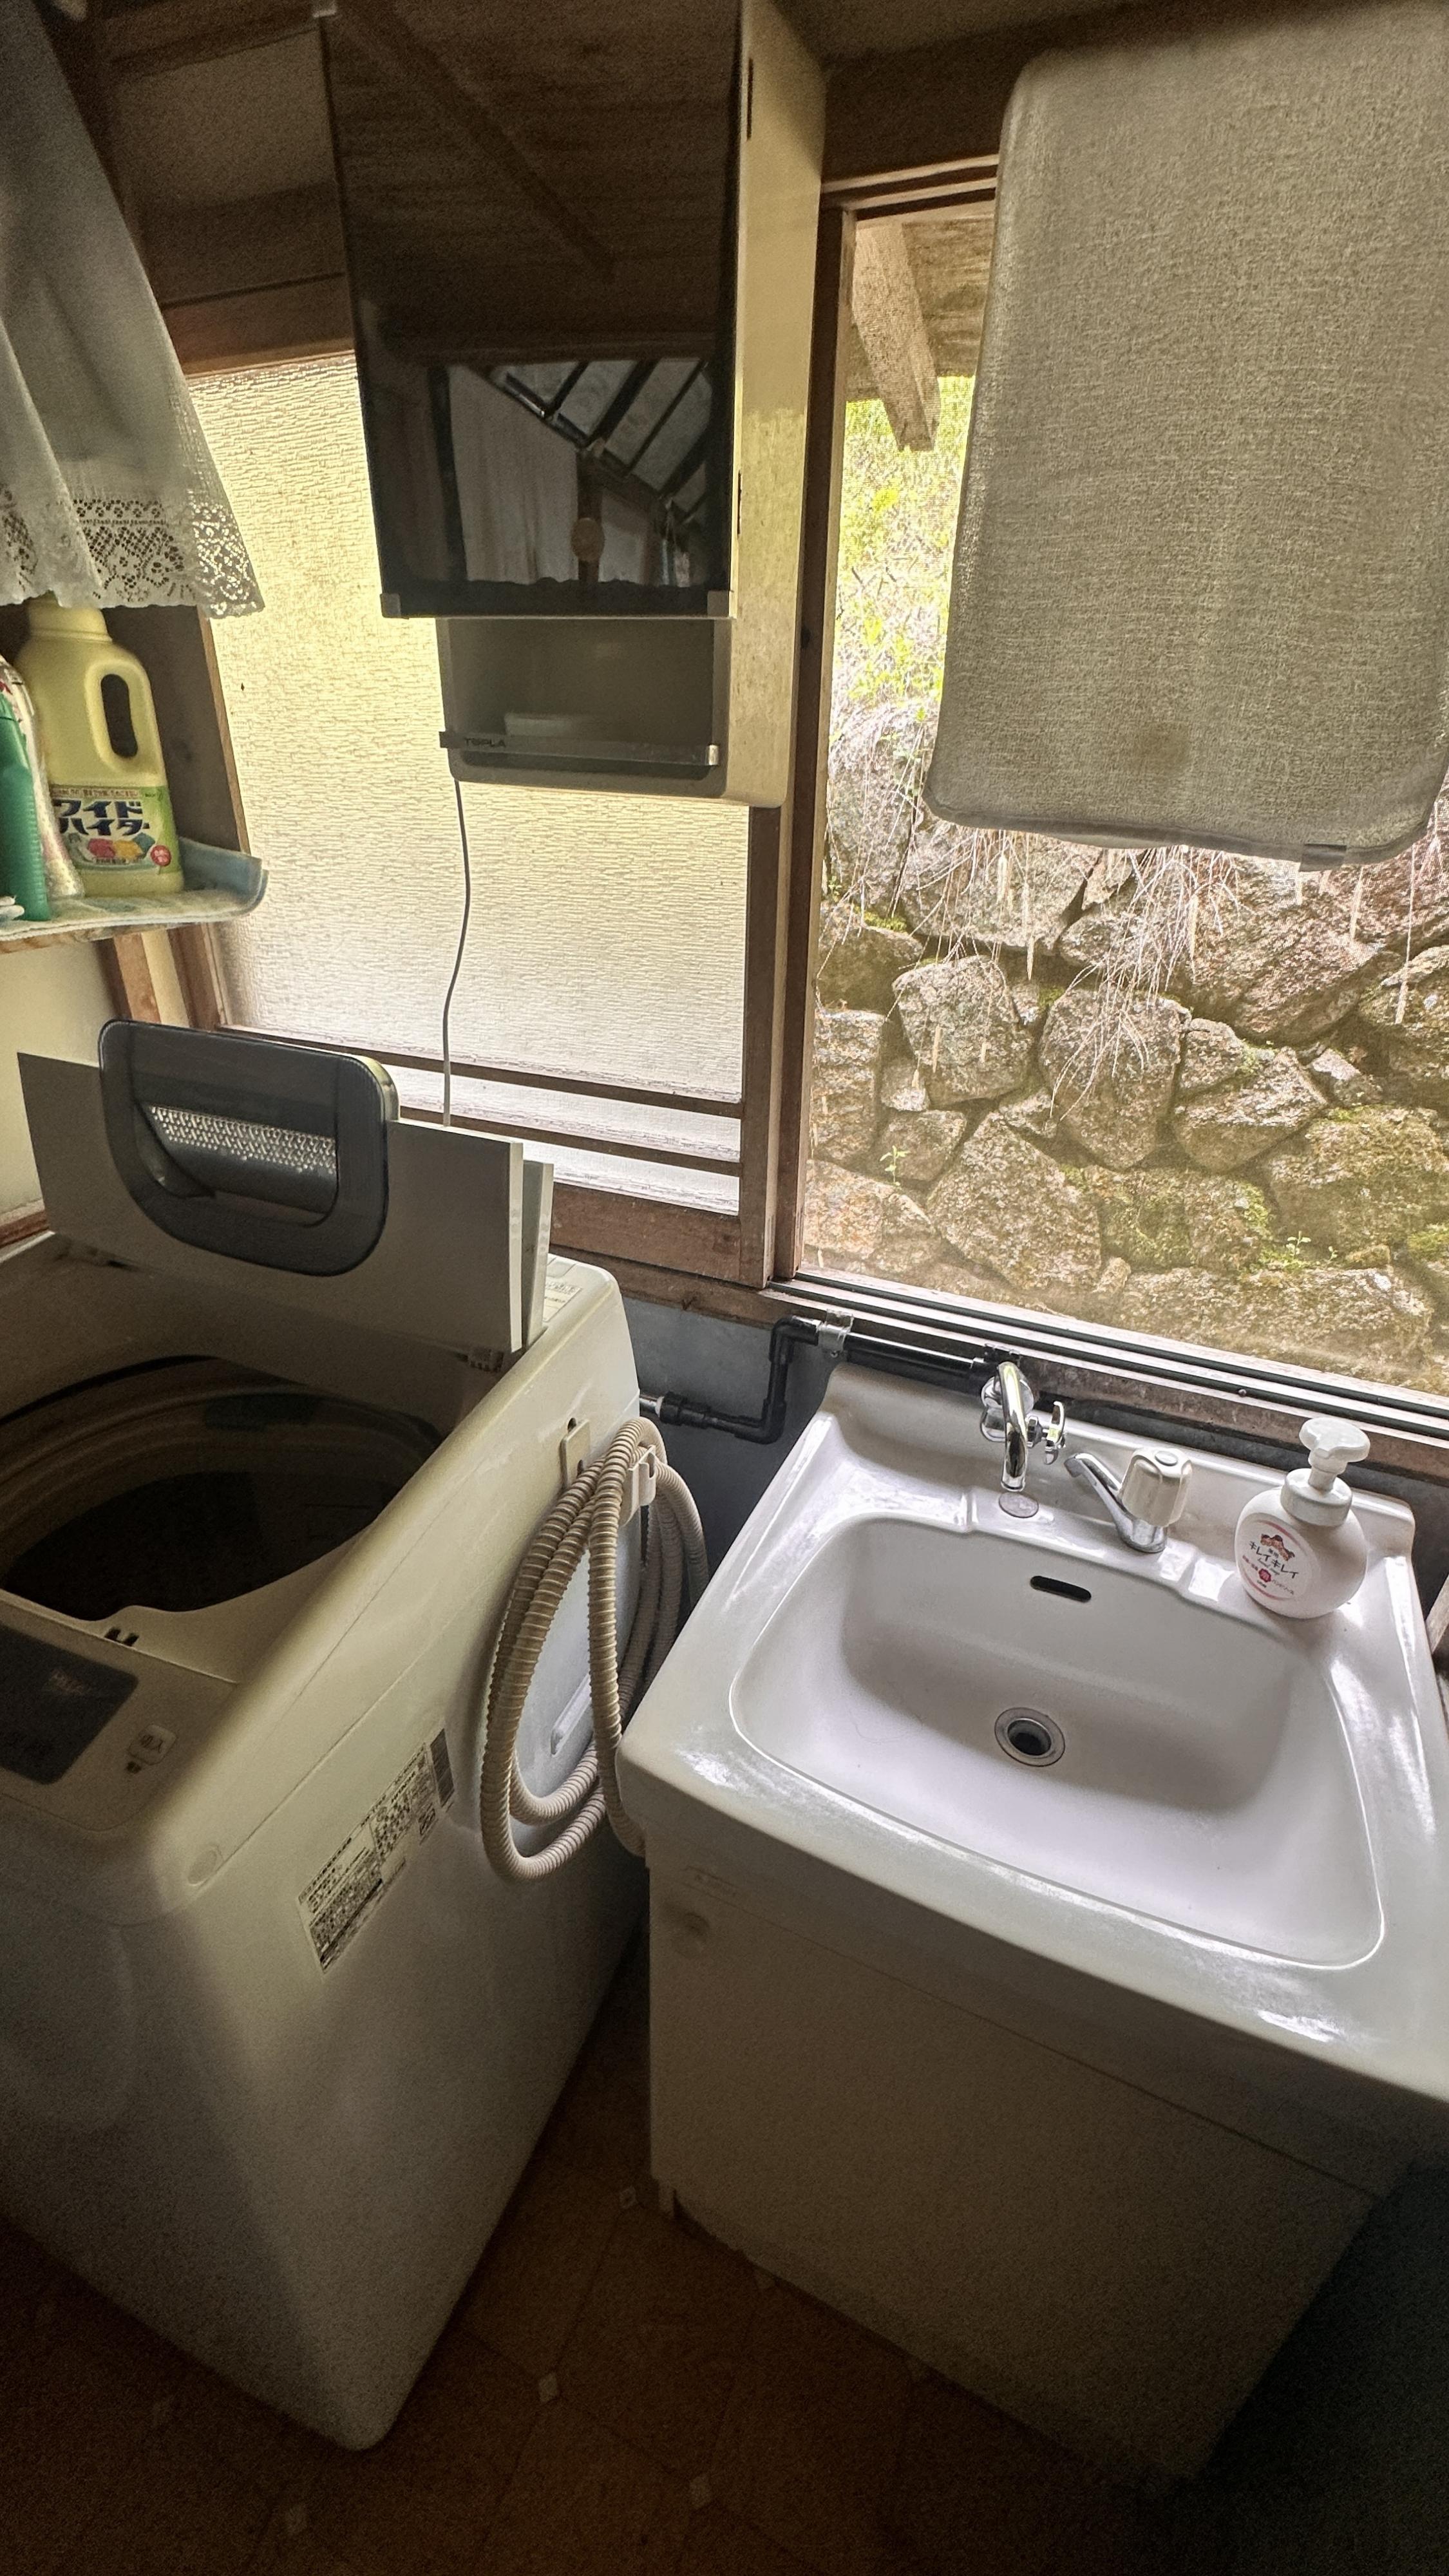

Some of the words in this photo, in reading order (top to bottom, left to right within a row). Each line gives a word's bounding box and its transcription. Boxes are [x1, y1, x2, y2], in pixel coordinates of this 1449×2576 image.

[52, 799, 143, 819] ワイド
[59, 817, 149, 836] ハイター
[1249, 1540, 1299, 1579] キレイキレイ
